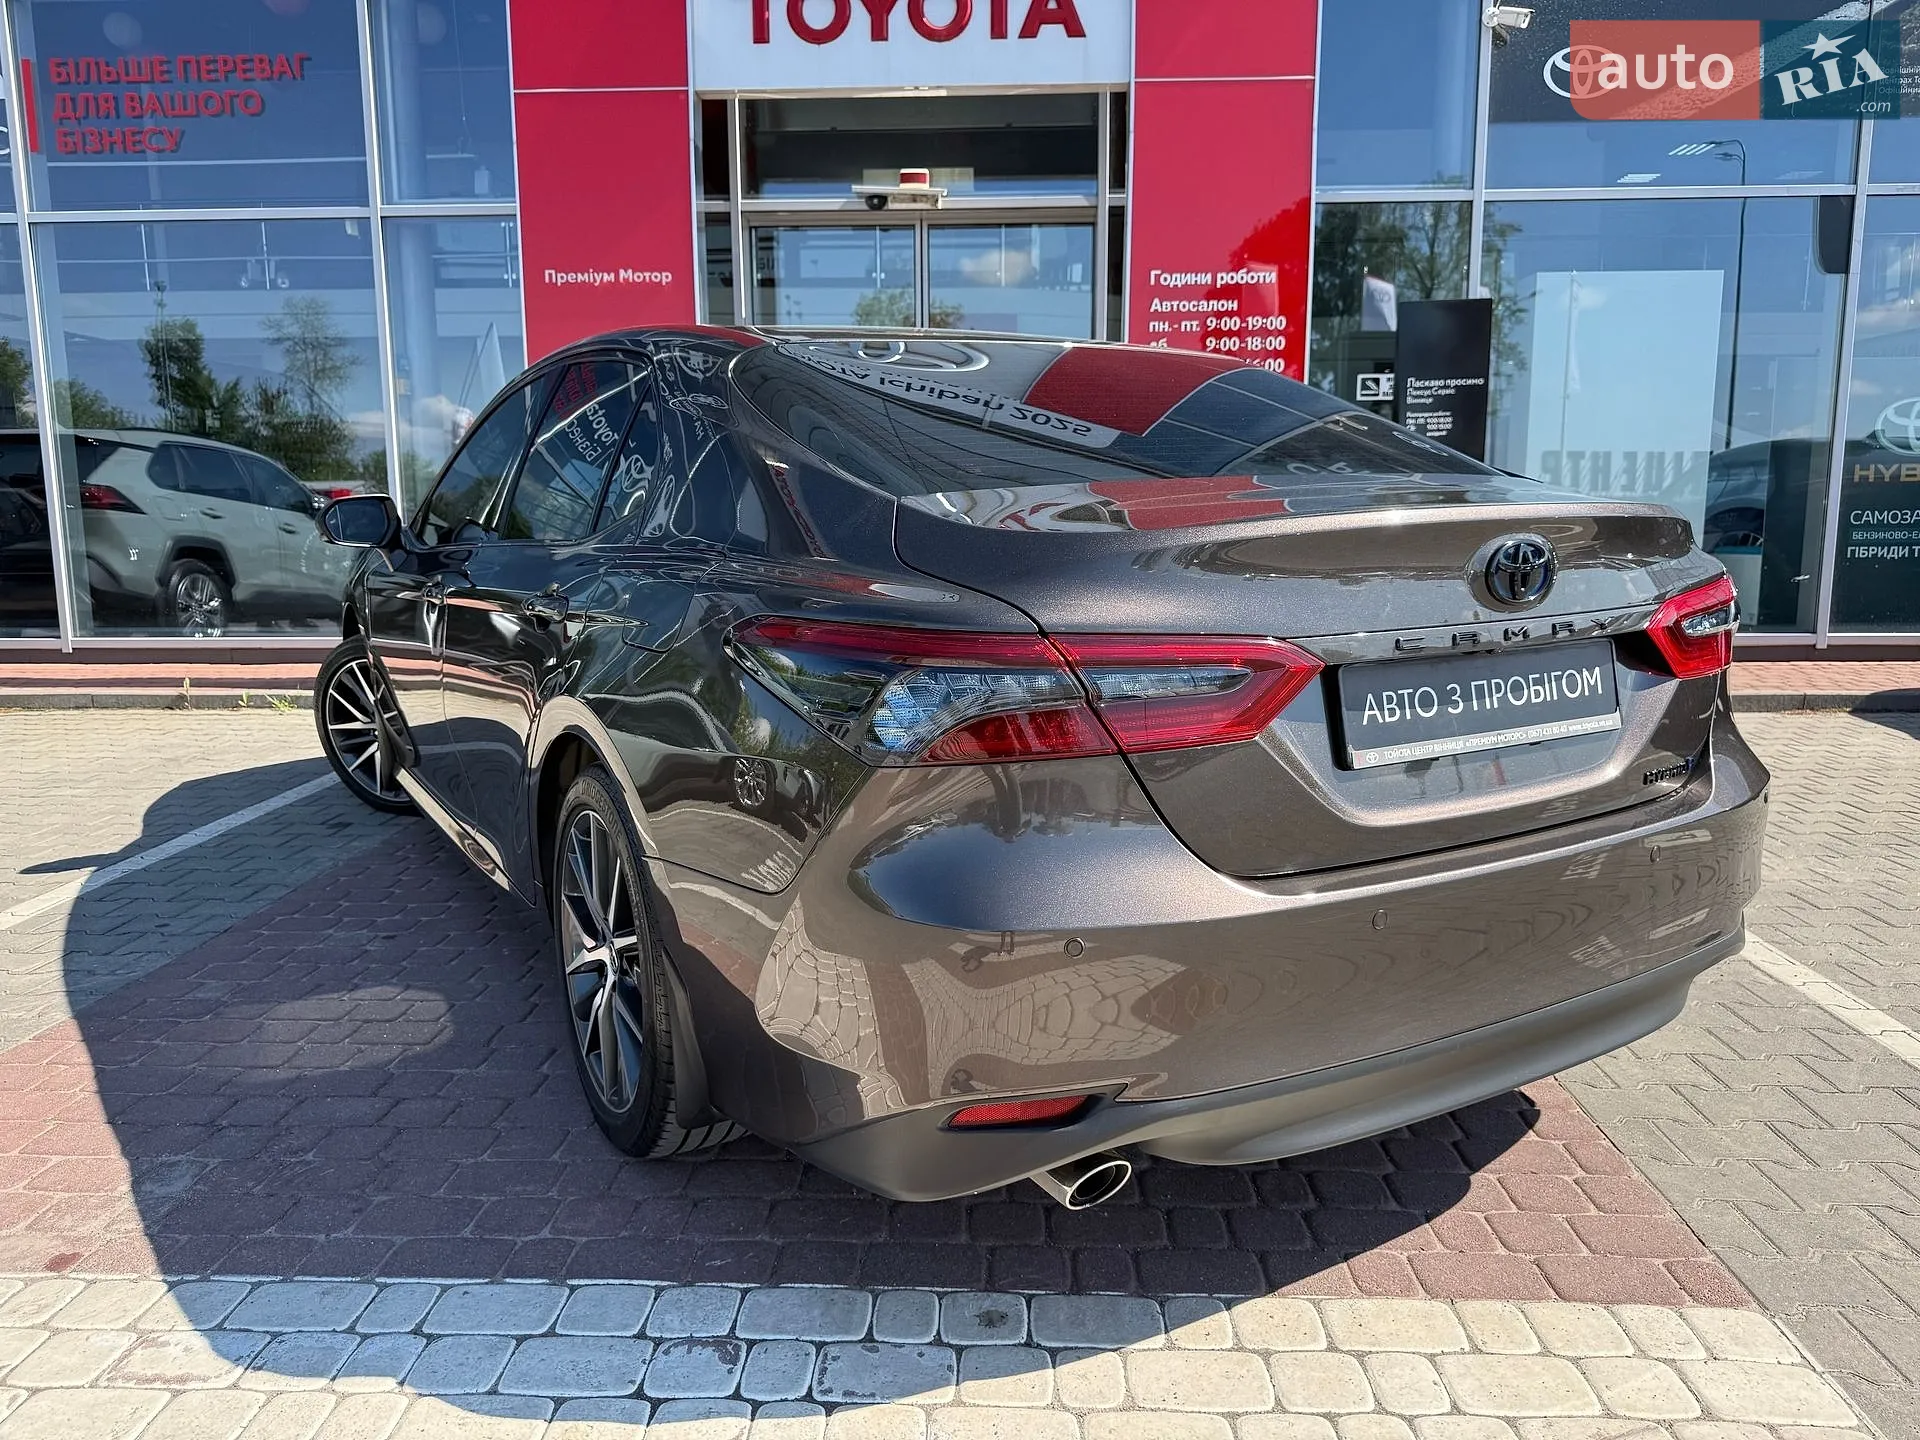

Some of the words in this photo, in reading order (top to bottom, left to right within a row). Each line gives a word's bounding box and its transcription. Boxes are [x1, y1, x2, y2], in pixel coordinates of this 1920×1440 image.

[752, 0, 1086, 44] TOYOTA
[49, 56, 170, 83] БІЛЬШЕ
[178, 53, 308, 82] ПЕРЕВАГ
[53, 92, 116, 123] ДЛЯ
[124, 89, 263, 118] ВАШОГО
[56, 126, 182, 155] БІЗНЕСУ
[544, 268, 615, 287] Преміум
[619, 268, 673, 286] Мотор
[1150, 269, 1212, 288] Години
[1216, 268, 1277, 288] роботи
[1150, 297, 1239, 313] Автосалон
[1206, 315, 1287, 331] 9:00-19:00
[1205, 336, 1287, 351] 9:00-18:00
[1446, 377, 1485, 388] просимо
[1847, 546, 1909, 560] ГІБРИДИ
[1395, 616, 1612, 651] CAMRY
[1362, 687, 1438, 726] АВТО
[1471, 666, 1603, 711] ПРОБІГОМ
[1384, 747, 1411, 760] ТОЙОТА
[1412, 744, 1433, 757] ЦЕНТР
